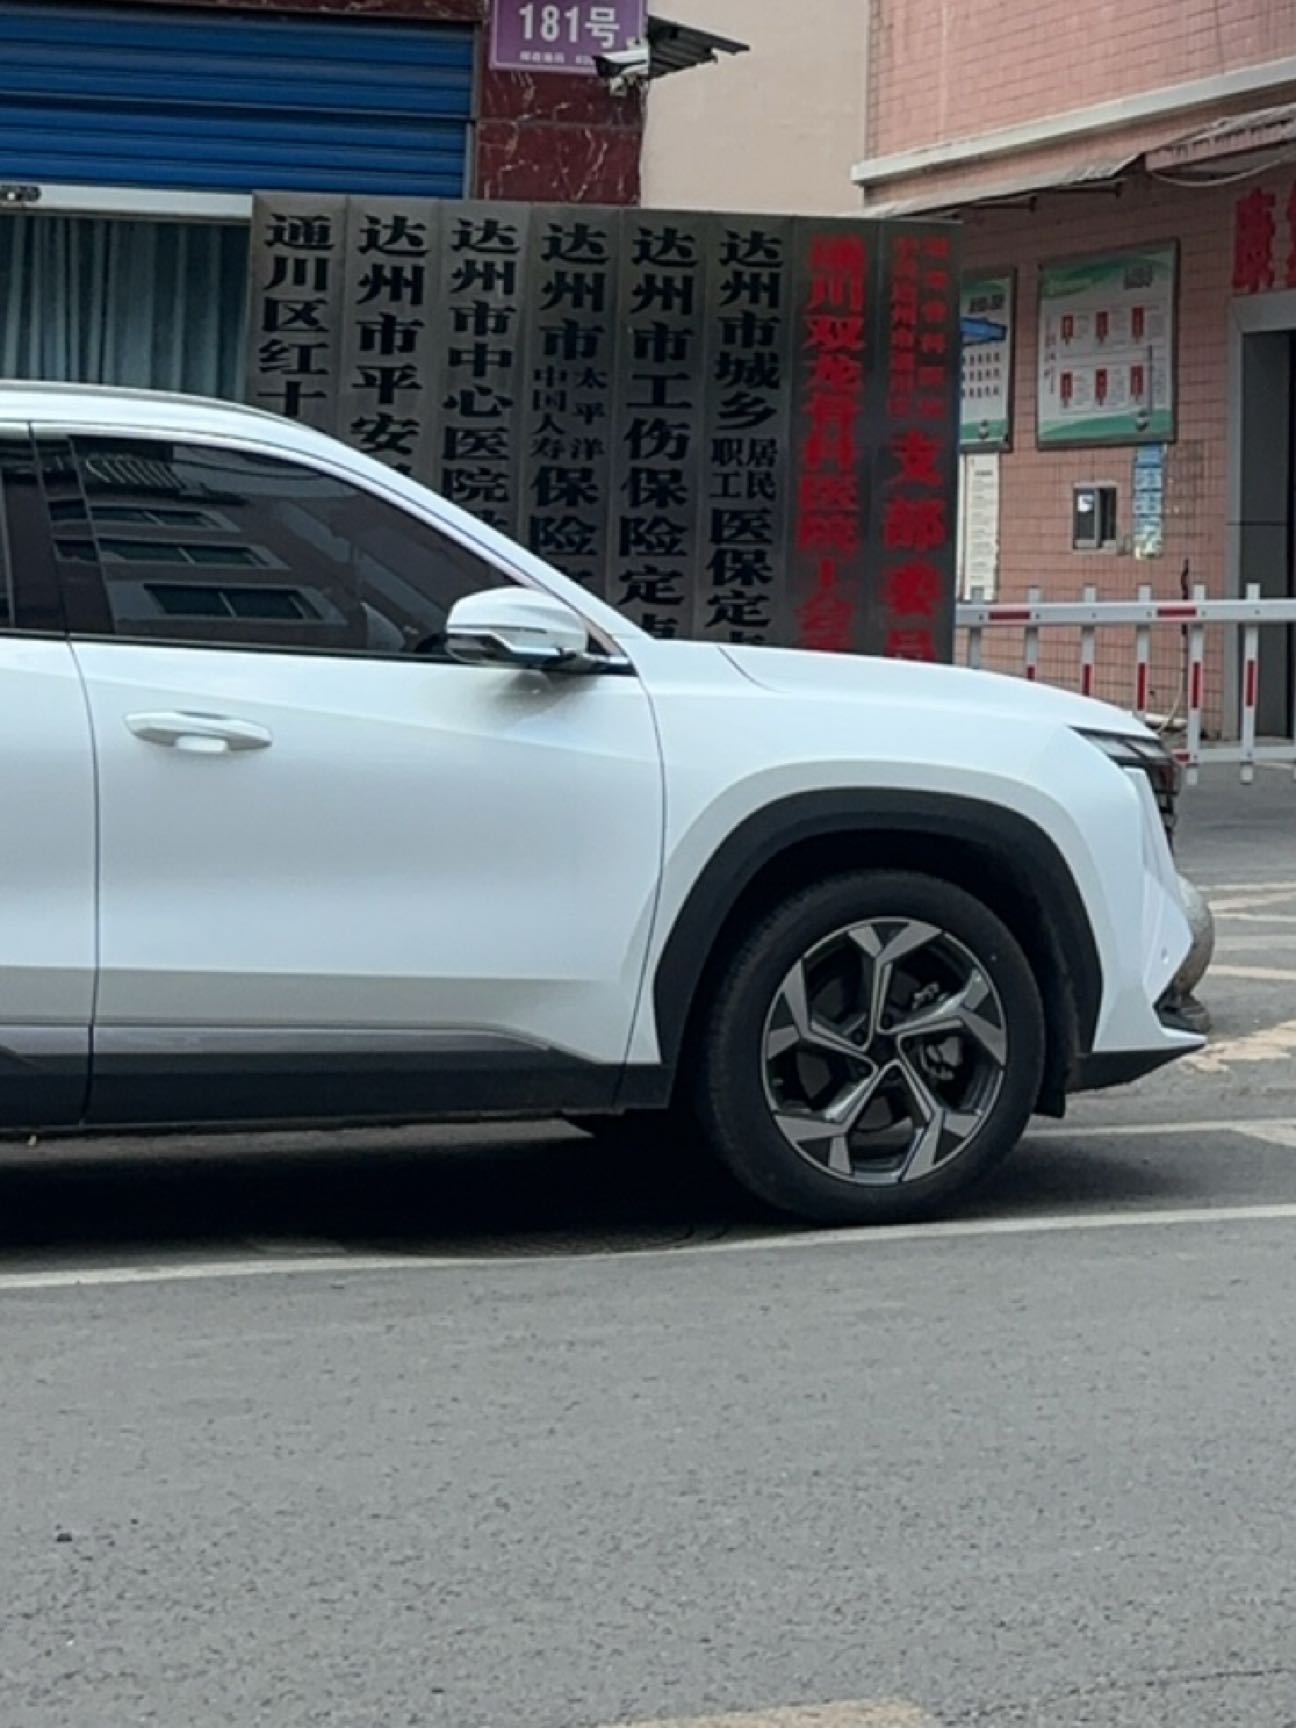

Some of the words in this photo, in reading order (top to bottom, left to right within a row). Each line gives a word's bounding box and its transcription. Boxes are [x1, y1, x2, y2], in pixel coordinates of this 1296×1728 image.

[518, 2, 621, 49] 181号
[257, 213, 334, 418] 通川区红十
[352, 215, 431, 475] 达州市平安
[441, 218, 521, 529] 达州市中心医院
